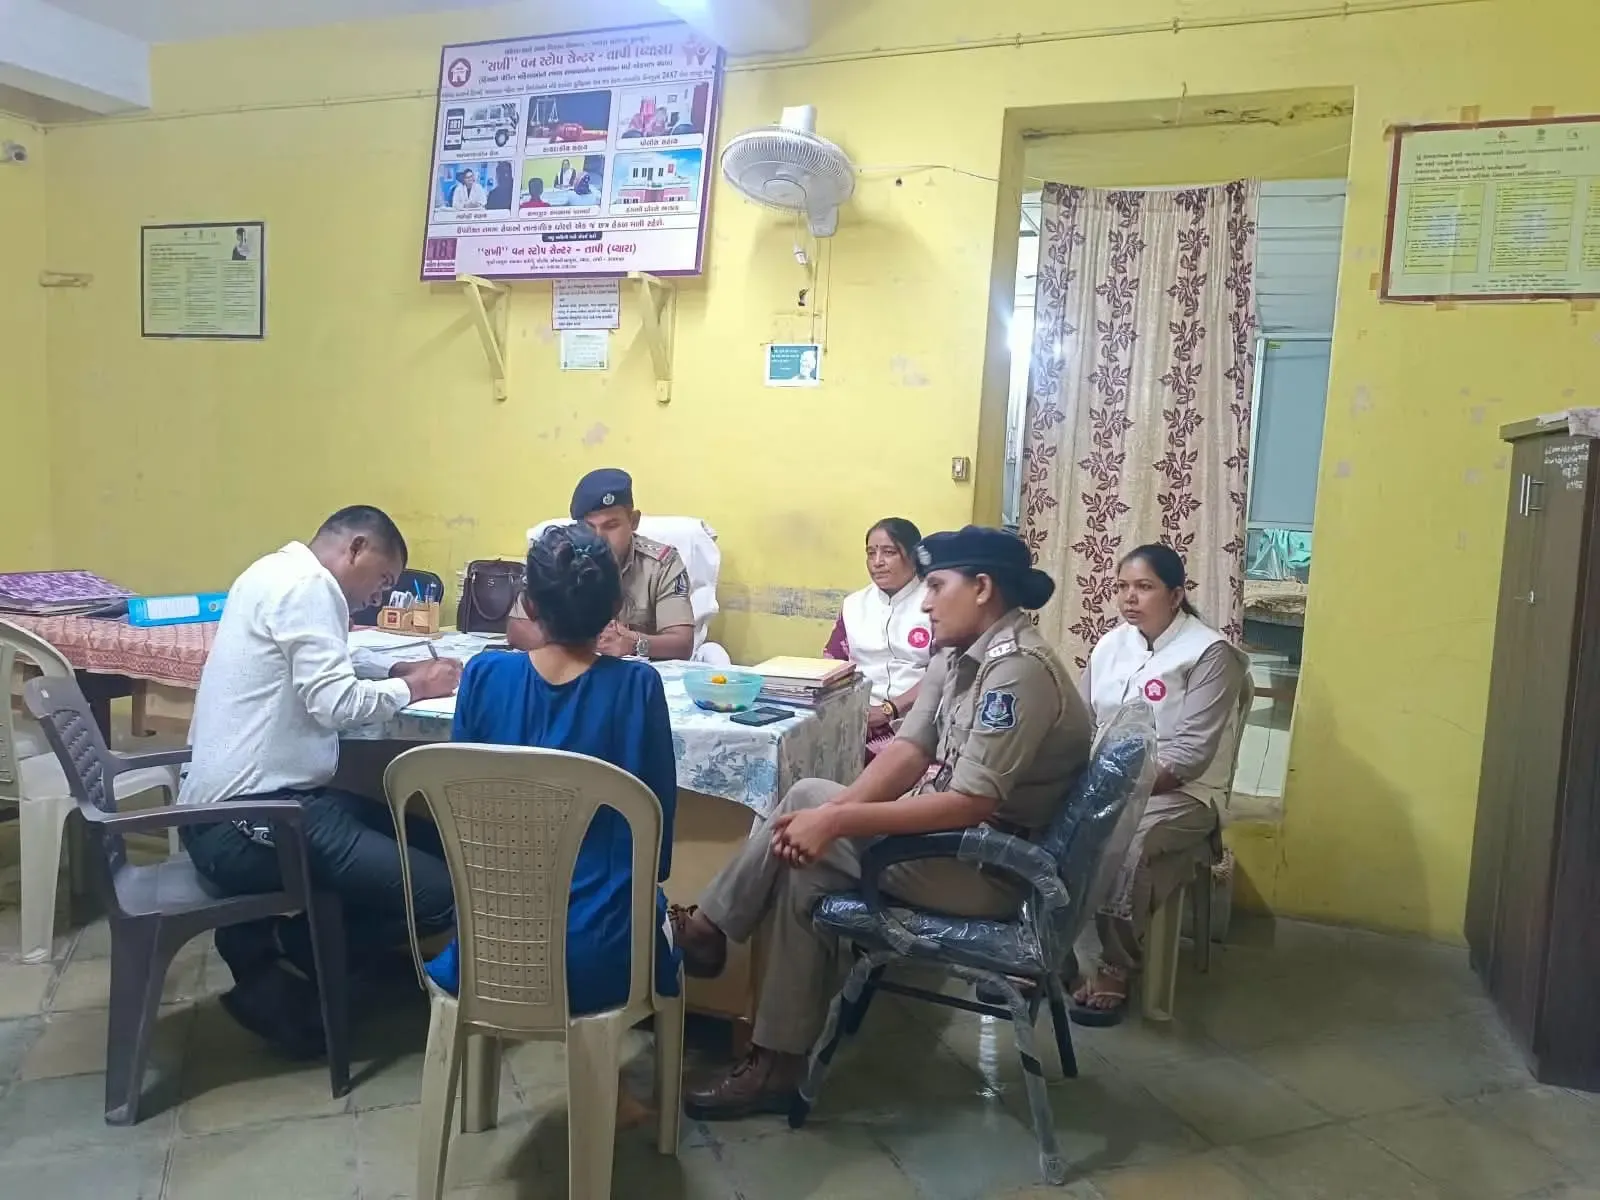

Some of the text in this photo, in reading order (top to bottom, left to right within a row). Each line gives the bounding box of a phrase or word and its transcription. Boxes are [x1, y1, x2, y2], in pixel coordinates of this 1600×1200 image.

[527, 244, 546, 256] સ્ટોપ
[549, 244, 572, 255] સેન્ટર
[584, 243, 604, 254] તાપી
